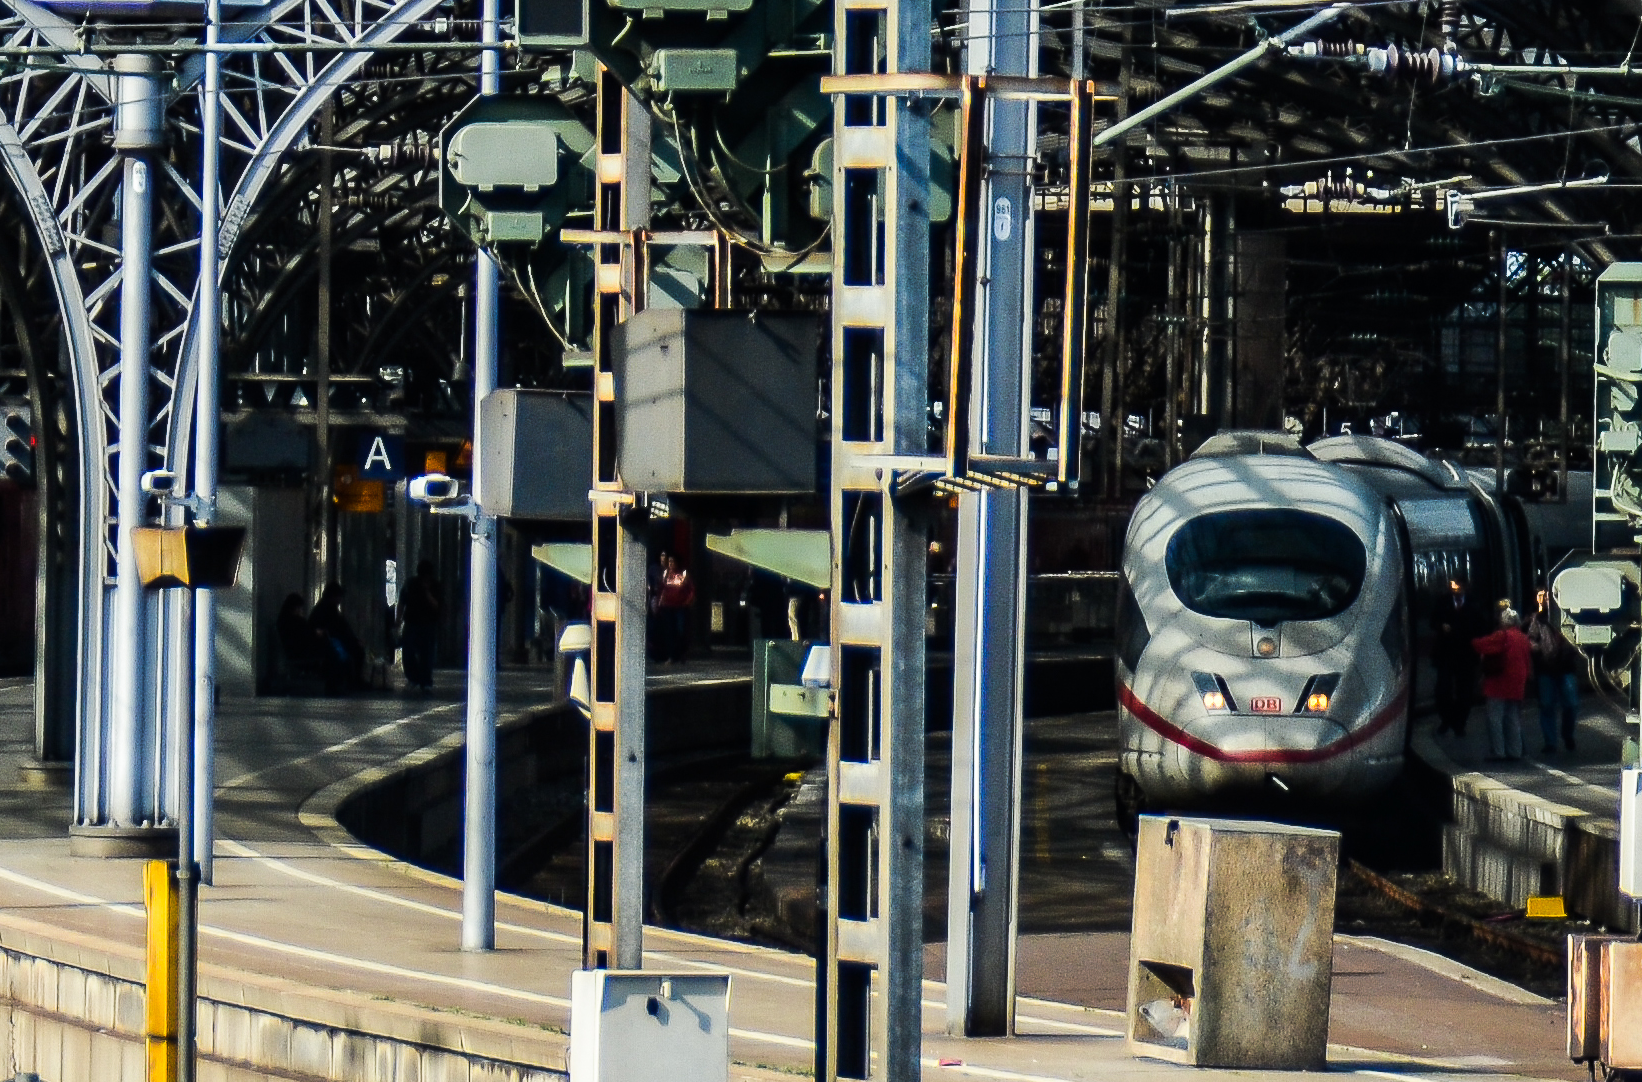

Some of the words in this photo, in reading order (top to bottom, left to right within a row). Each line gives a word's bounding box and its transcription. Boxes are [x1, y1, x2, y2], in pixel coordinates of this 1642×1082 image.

[1340, 422, 1352, 436] 5
[364, 436, 392, 470] A
[1254, 699, 1278, 709] DB
